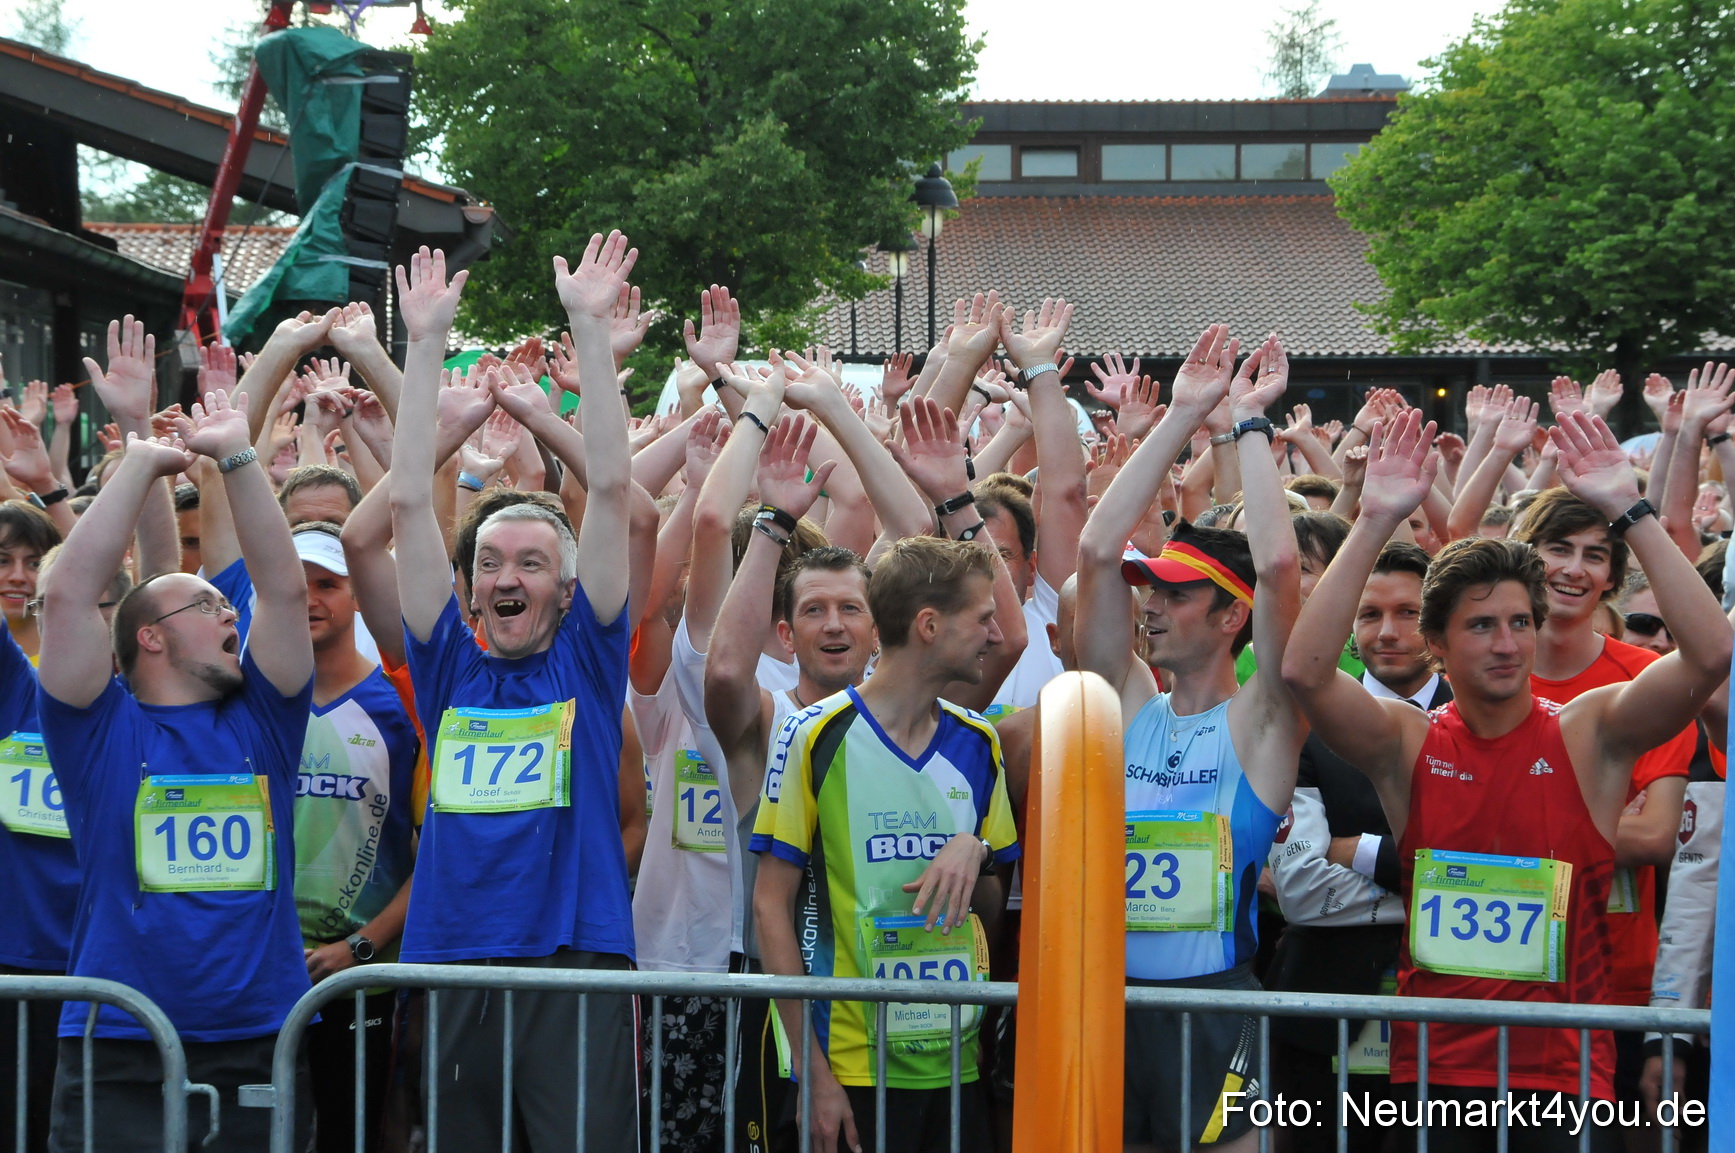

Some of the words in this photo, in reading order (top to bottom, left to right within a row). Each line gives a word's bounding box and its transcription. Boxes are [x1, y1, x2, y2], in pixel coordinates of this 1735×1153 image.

[458, 729, 504, 738] firmenlauf
[454, 742, 544, 785] 172
[469, 787, 501, 797] Josef
[868, 811, 937, 830] TEAM
[155, 814, 251, 861] 160
[866, 833, 957, 863] BOC
[1287, 840, 1312, 856] GENTS
[1679, 852, 1704, 864] GENTS
[168, 863, 222, 874] Bernhard
[1125, 852, 1181, 900] 23
[1435, 875, 1485, 887] firmenlauf
[1125, 902, 1156, 912] Marco
[1320, 887, 1336, 916] powered
[1421, 895, 1543, 945] 1337
[895, 1009, 930, 1021] Michael
[1364, 1047, 1389, 1057] Mart
